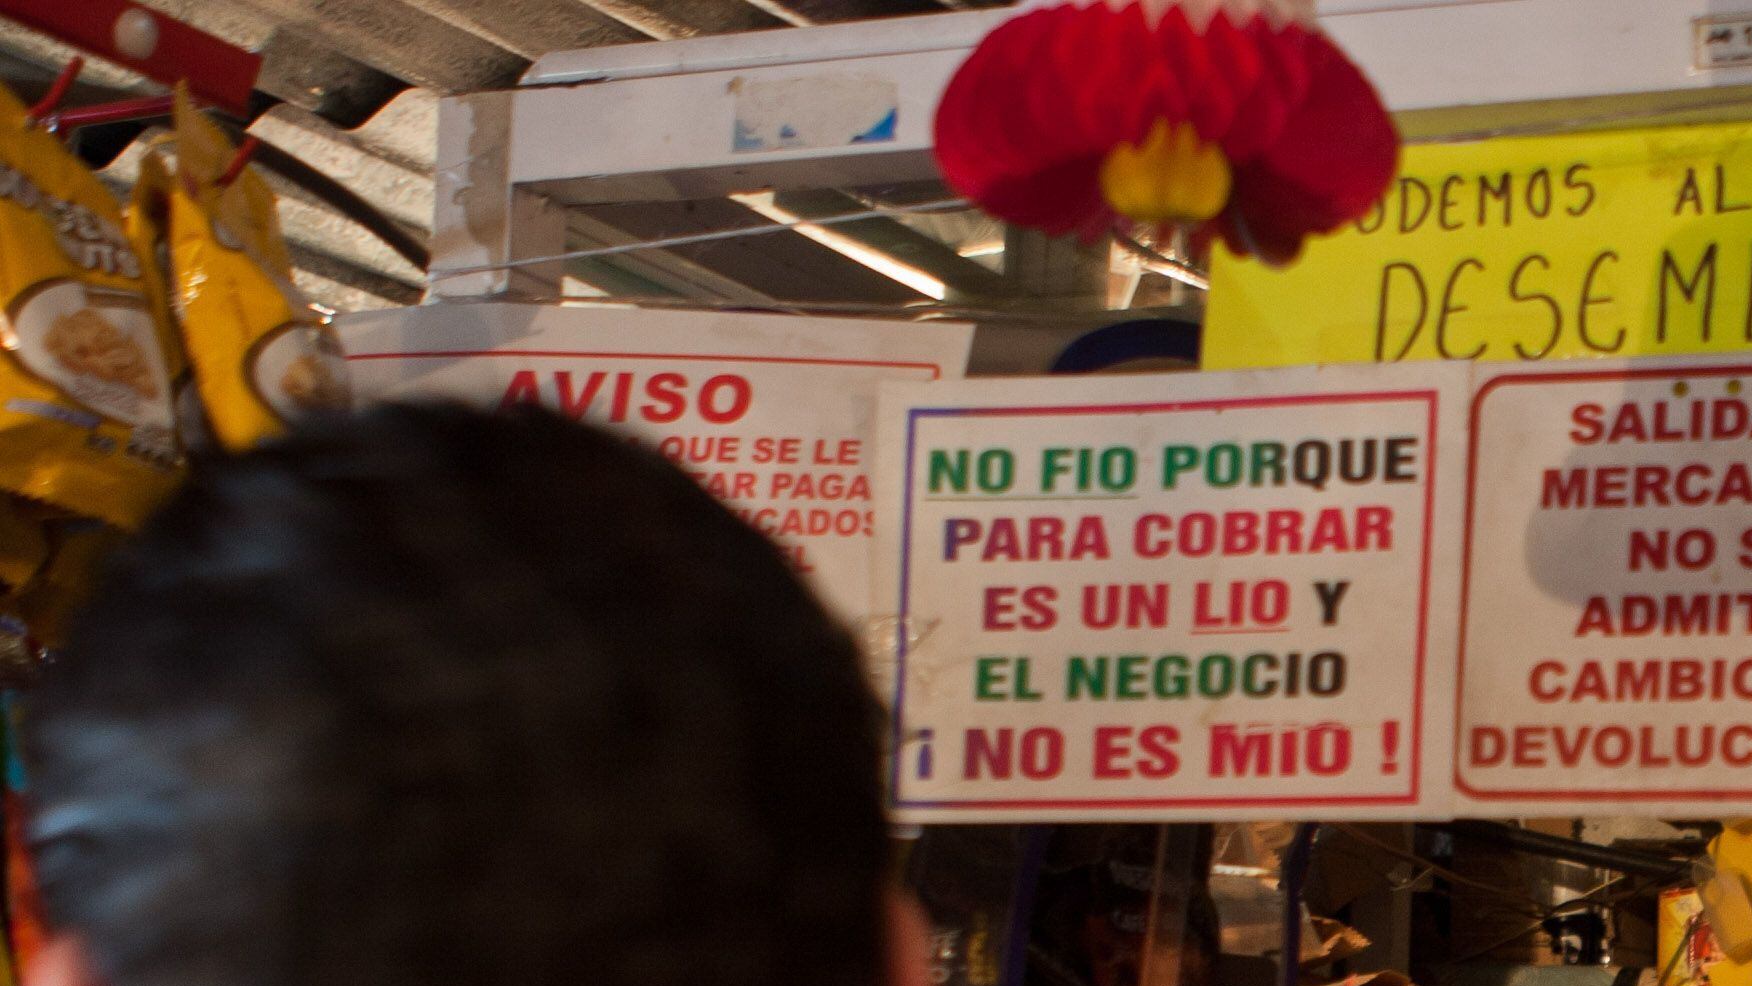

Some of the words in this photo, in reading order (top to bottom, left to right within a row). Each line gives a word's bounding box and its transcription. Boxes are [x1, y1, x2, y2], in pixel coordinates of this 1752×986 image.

[1676, 163, 1752, 216] AL
[499, 370, 753, 424] AVISO
[659, 436, 740, 464] QUE
[752, 437, 801, 464] SE
[813, 439, 862, 465] LE
[927, 448, 1014, 494] NO
[1041, 446, 1138, 492] FIO
[1163, 437, 1419, 491] PORQUE
[943, 516, 1110, 561] PARA
[1133, 505, 1394, 560] COBRAR
[1628, 530, 1715, 571] NO
[982, 586, 1058, 632] ES
[1082, 583, 1170, 630] UN
[1192, 580, 1292, 628] LIO
[1312, 581, 1351, 626] Y
[974, 656, 1043, 702] EL
[1066, 650, 1347, 702] NEGOCIO
[962, 726, 1065, 780] NO
[1092, 725, 1181, 780] ES
[1208, 721, 1353, 778] MIO
